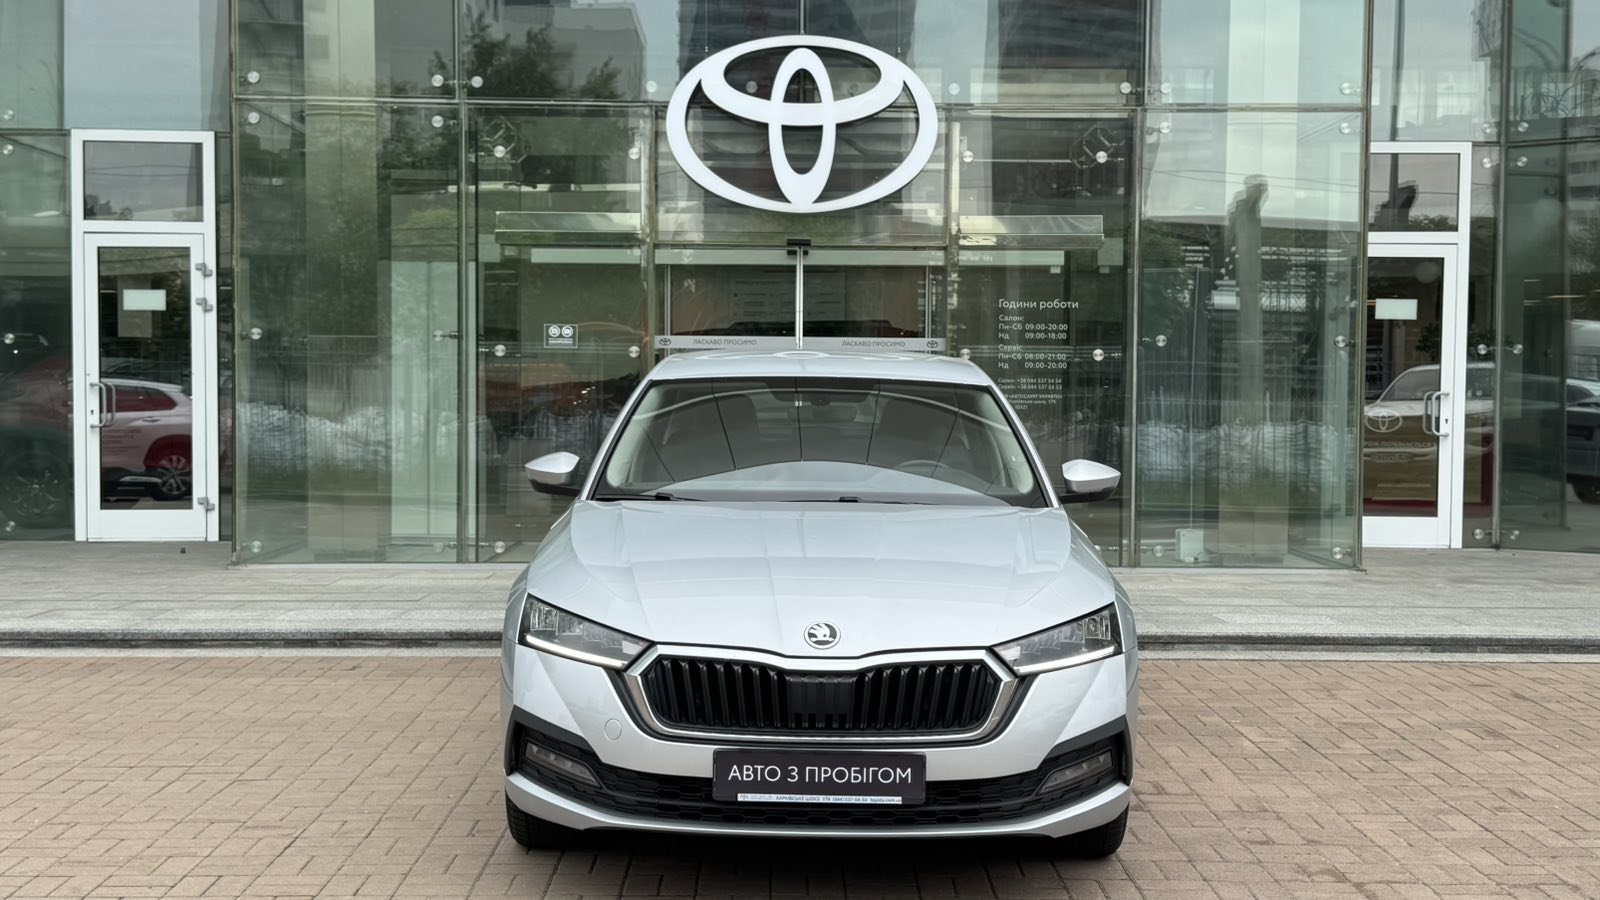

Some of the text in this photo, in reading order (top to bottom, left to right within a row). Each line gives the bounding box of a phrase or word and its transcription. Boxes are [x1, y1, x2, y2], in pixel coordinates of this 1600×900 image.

[999, 299, 1079, 310] Години роботи
[999, 314, 1024, 322] Салон:
[999, 332, 1010, 340] Нд
[998, 362, 1009, 370] Нд
[728, 765, 912, 783] АВТО З ПРОБІГОМ
